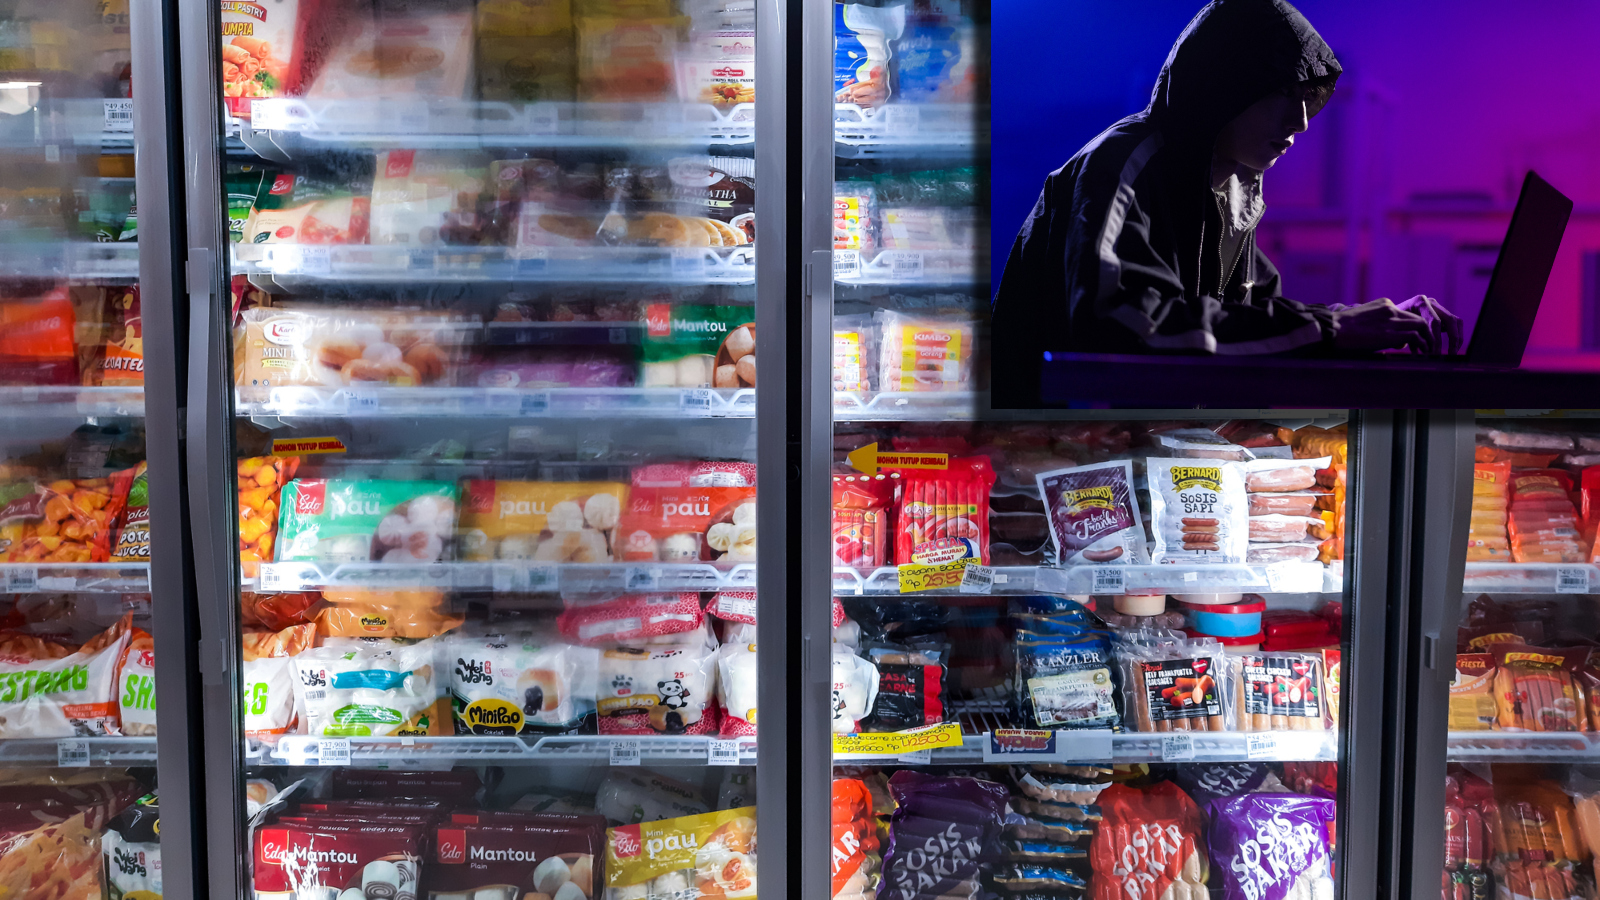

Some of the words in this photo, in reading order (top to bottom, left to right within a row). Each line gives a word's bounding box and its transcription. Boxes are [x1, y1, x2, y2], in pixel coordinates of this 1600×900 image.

[237, 2, 264, 18] PASTRY
[673, 318, 727, 333] Mantou
[914, 333, 951, 342] KIMBO
[262, 347, 287, 358] MINI
[297, 442, 318, 451] TUTUP
[877, 456, 898, 465] MOHON
[900, 456, 920, 465] TUTUP
[920, 456, 946, 466] KEMBALI
[1063, 485, 1114, 508] BERNARDI
[299, 494, 322, 510] Edo
[331, 500, 381, 521] pau
[500, 500, 547, 518] pau
[662, 502, 711, 521] pau
[1184, 503, 1215, 514] SAPI
[1072, 511, 1118, 540] Franks
[914, 537, 966, 555] SPECIAL
[941, 547, 965, 555] MURAH
[457, 657, 484, 675] Wei
[1036, 651, 1101, 668] KANZLER
[1460, 660, 1486, 669] FIESTA
[455, 667, 493, 686] Wang
[631, 697, 655, 707] PAO
[468, 705, 521, 725] MiniPao
[645, 829, 664, 838] Mini
[293, 846, 358, 864] Mantou
[440, 841, 462, 859] Edo
[470, 845, 537, 863] Mantou
[647, 832, 699, 860] pau
[1230, 811, 1293, 884] SOSIS
[115, 846, 138, 865] Wei
[1124, 823, 1185, 900] BAKAR
[113, 857, 147, 877] Wang
[470, 862, 488, 870] Plain
